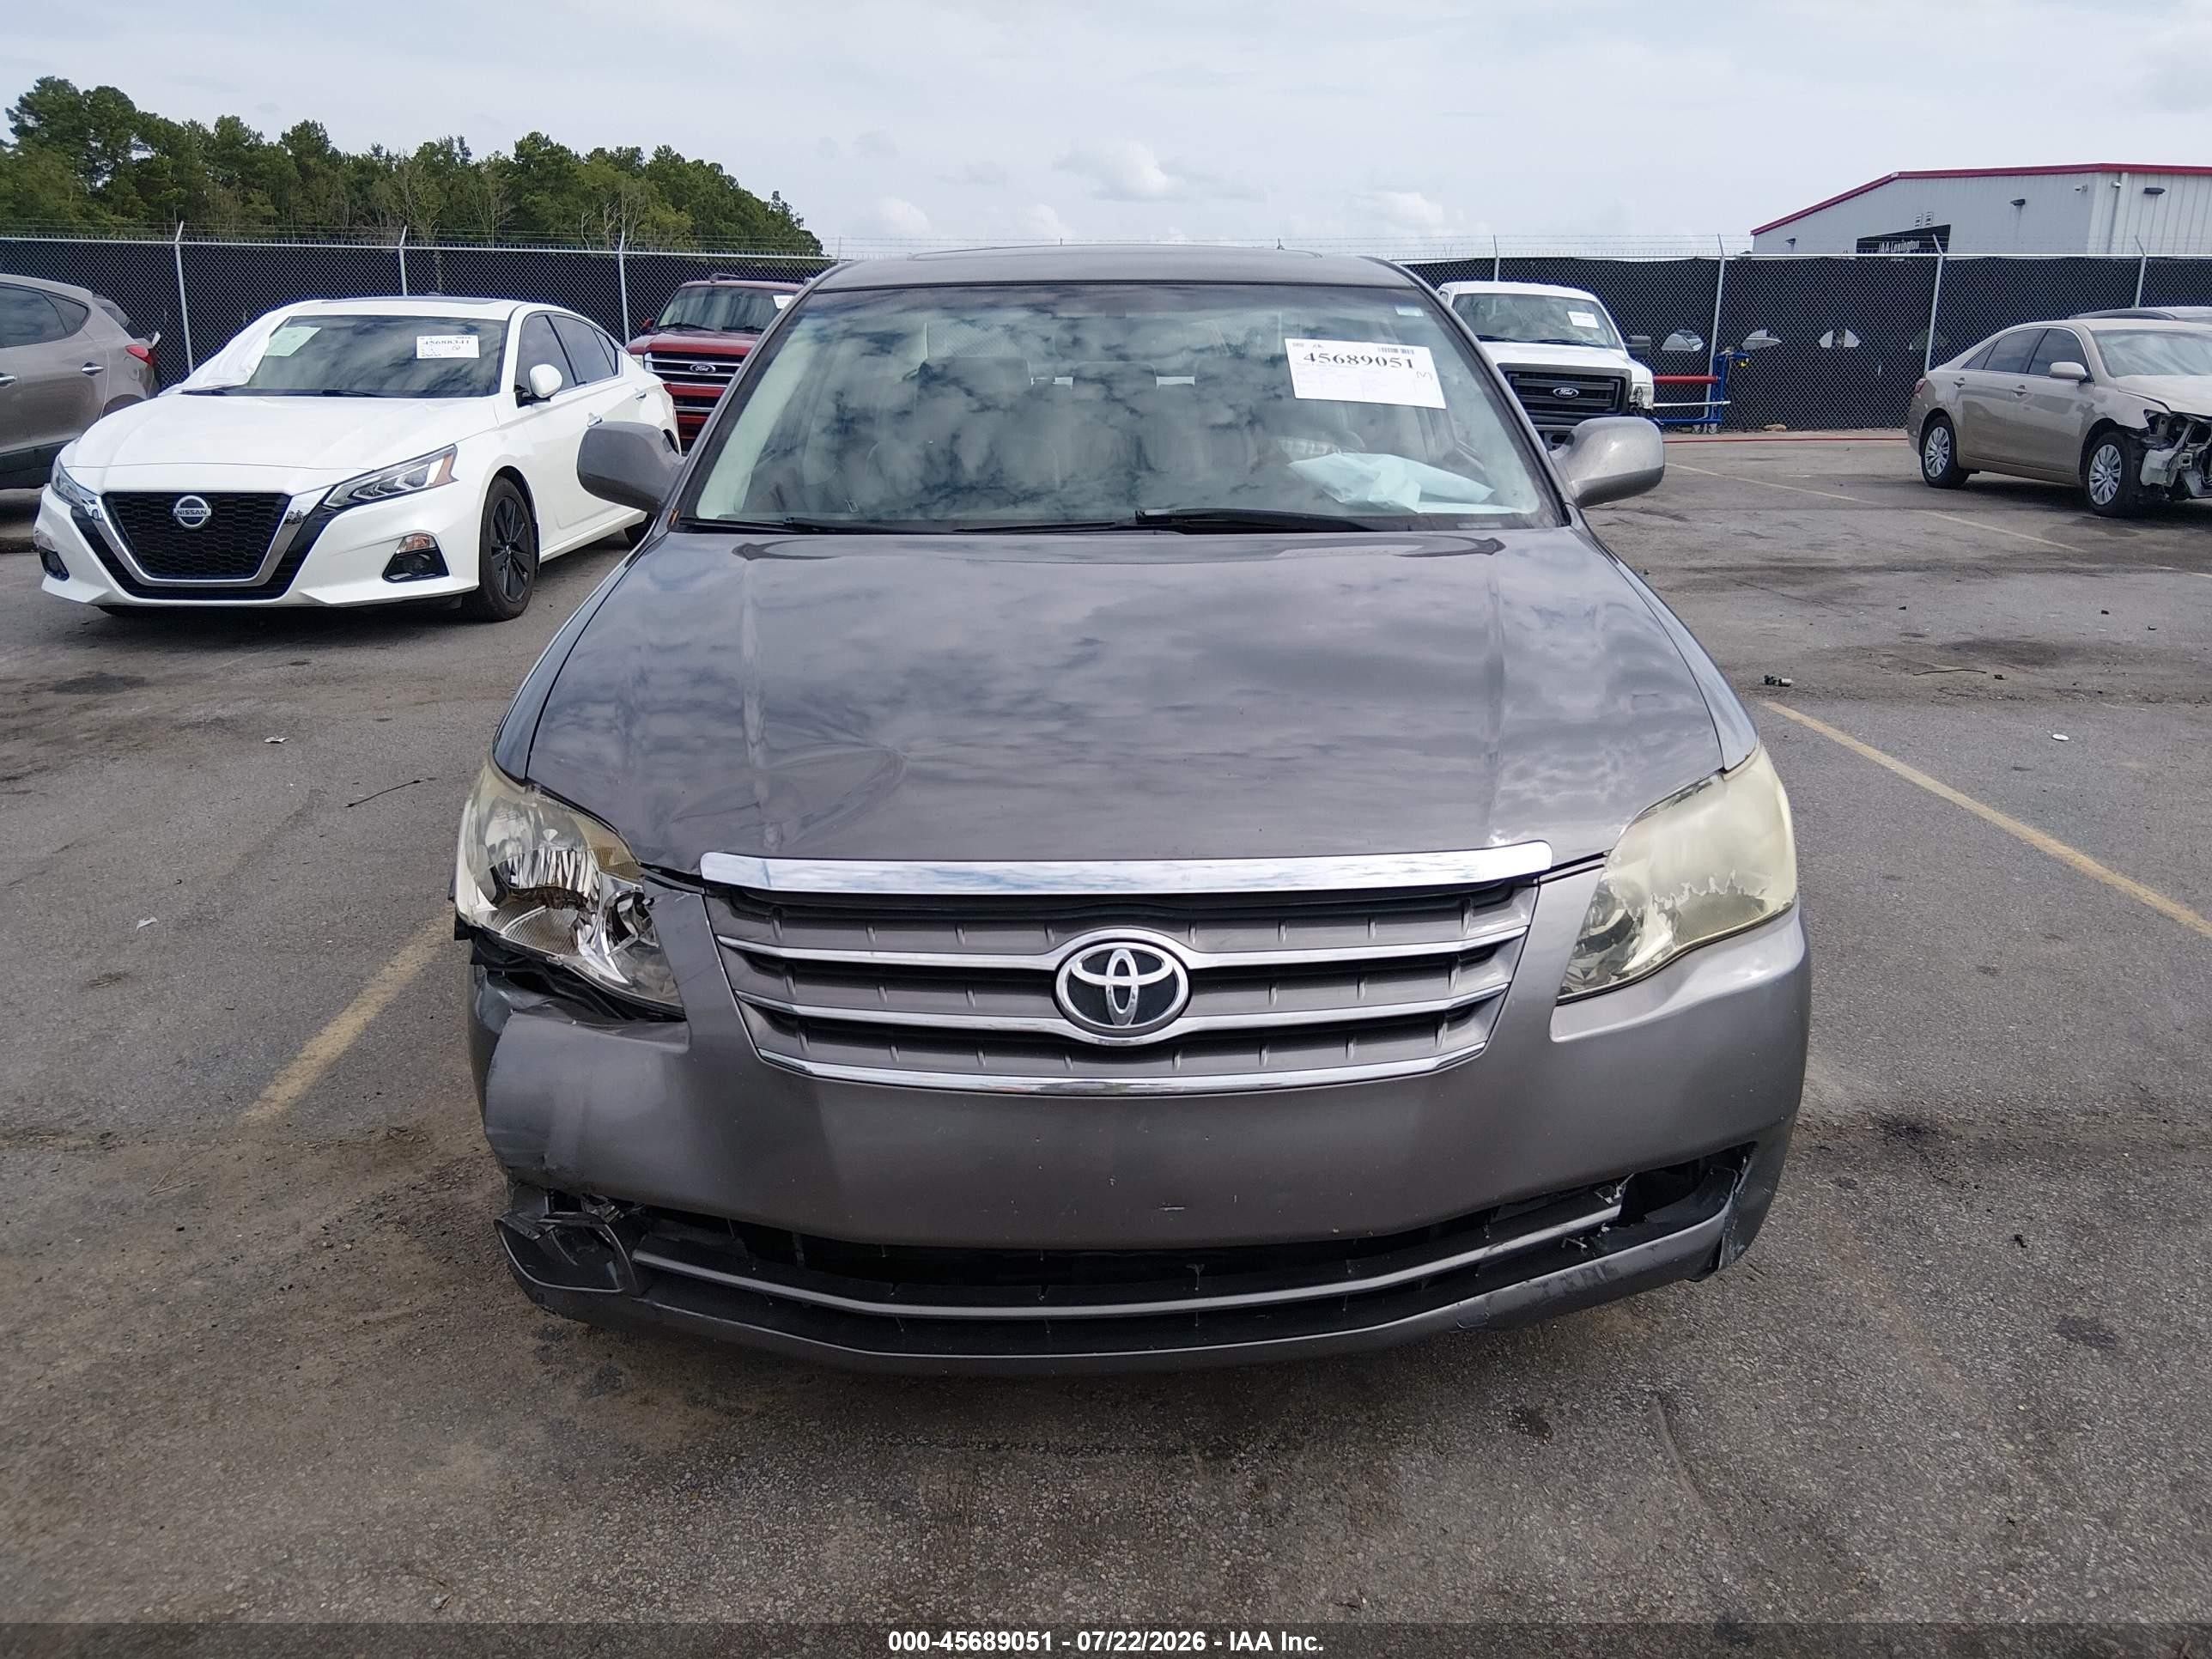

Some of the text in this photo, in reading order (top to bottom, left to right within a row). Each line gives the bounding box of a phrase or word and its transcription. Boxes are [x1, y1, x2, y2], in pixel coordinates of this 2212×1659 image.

[1878, 240, 1920, 253] IAA Lexington
[1304, 352, 1414, 369] 45689051
